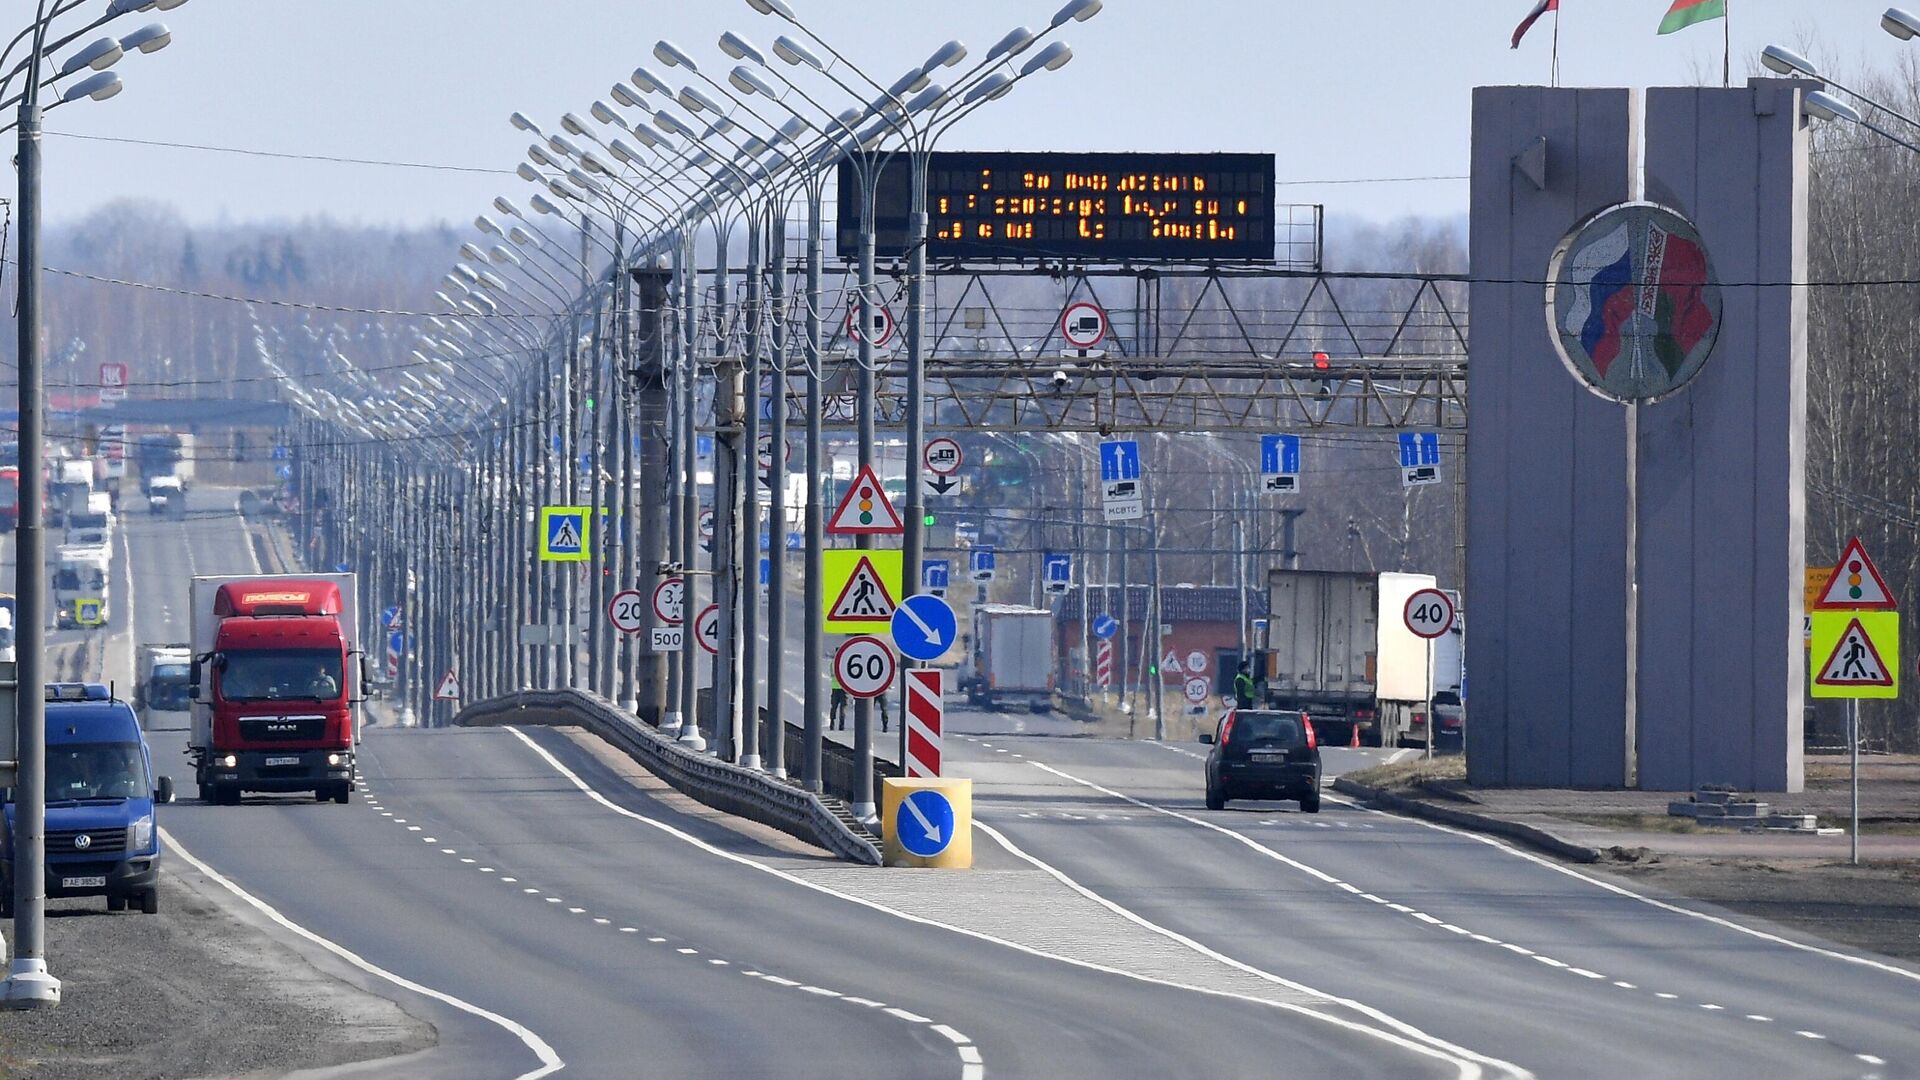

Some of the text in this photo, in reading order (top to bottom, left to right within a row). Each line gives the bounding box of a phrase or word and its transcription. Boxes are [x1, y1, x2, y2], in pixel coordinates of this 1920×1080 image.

[1412, 603, 1443, 623] 40
[705, 619, 718, 639] 4
[654, 633, 681, 645] 500
[847, 654, 883, 680] 60
[1189, 684, 1204, 696] 30
[267, 724, 297, 732] MAN
